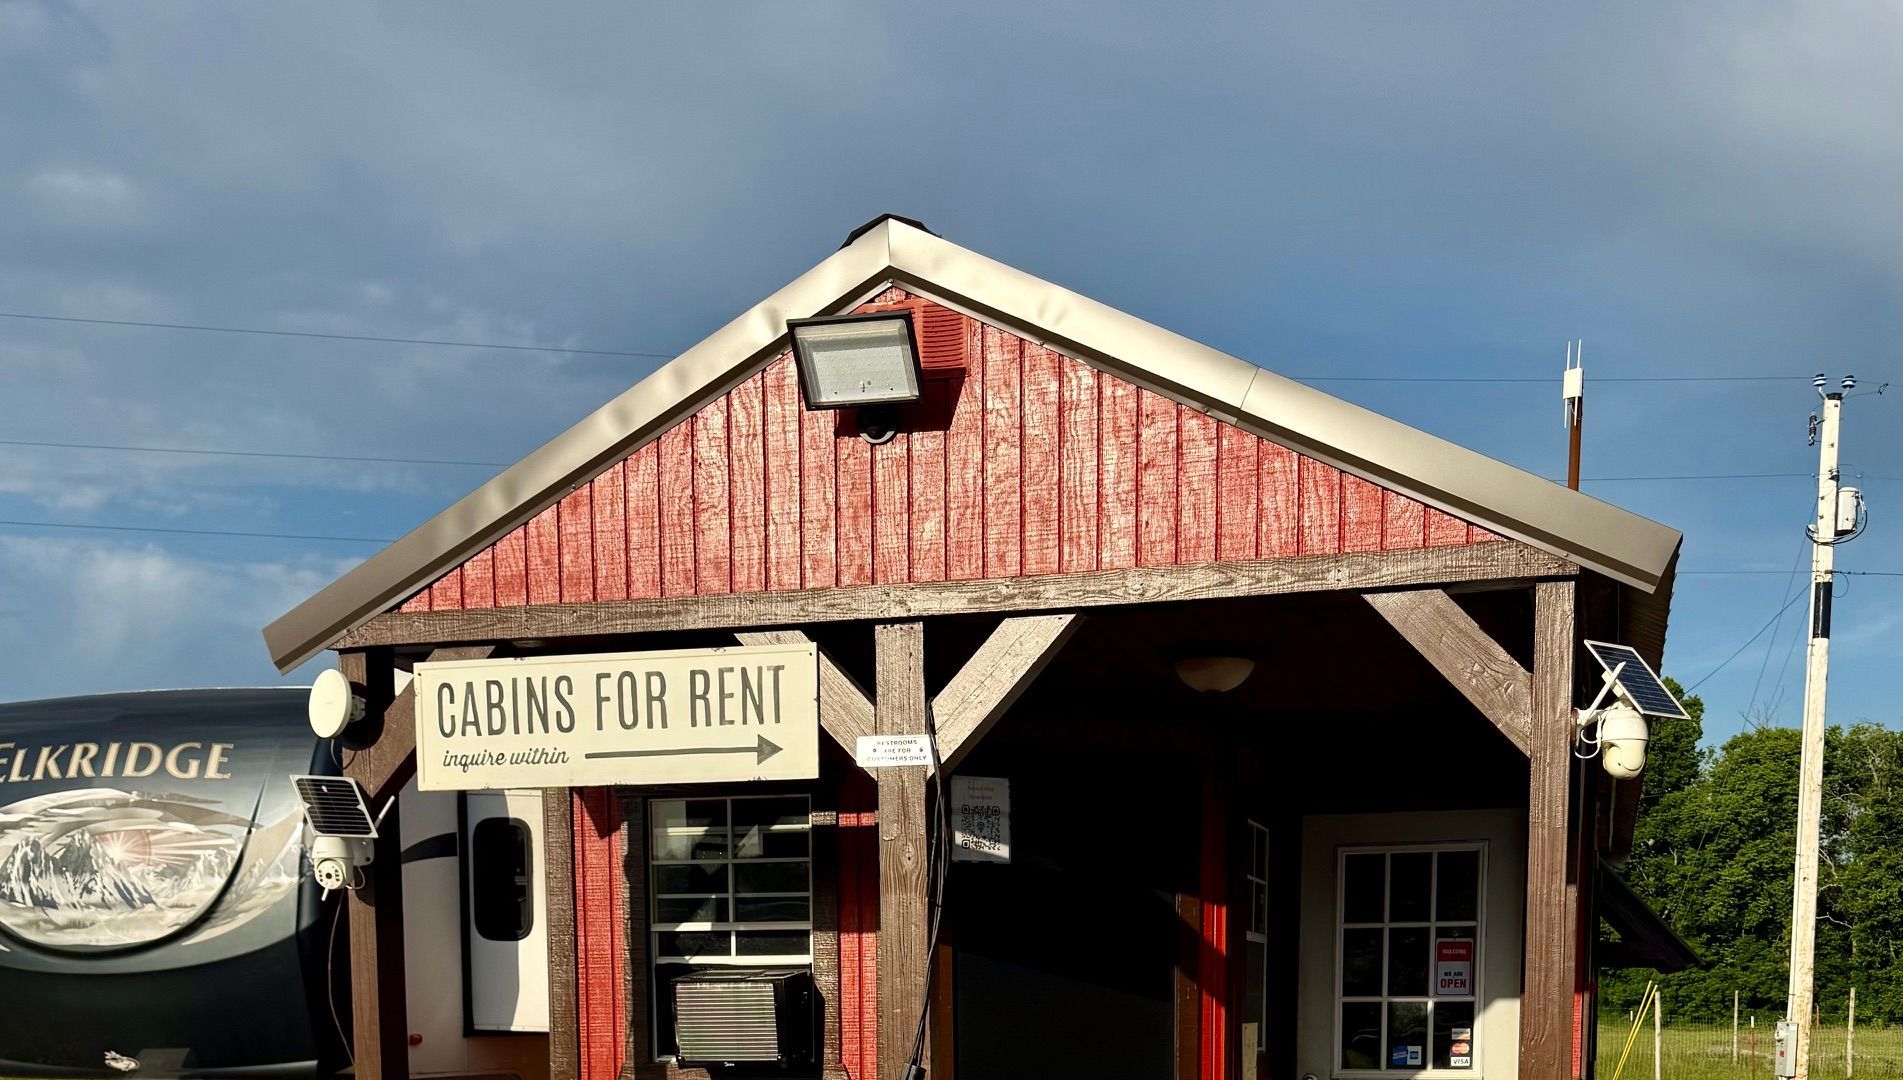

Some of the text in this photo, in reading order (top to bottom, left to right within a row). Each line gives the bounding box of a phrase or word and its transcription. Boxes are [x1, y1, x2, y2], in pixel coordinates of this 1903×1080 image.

[437, 664, 785, 739] CABINS FOR RENT
[442, 747, 570, 774] inquire within
[1440, 978, 1467, 989] OPEN
